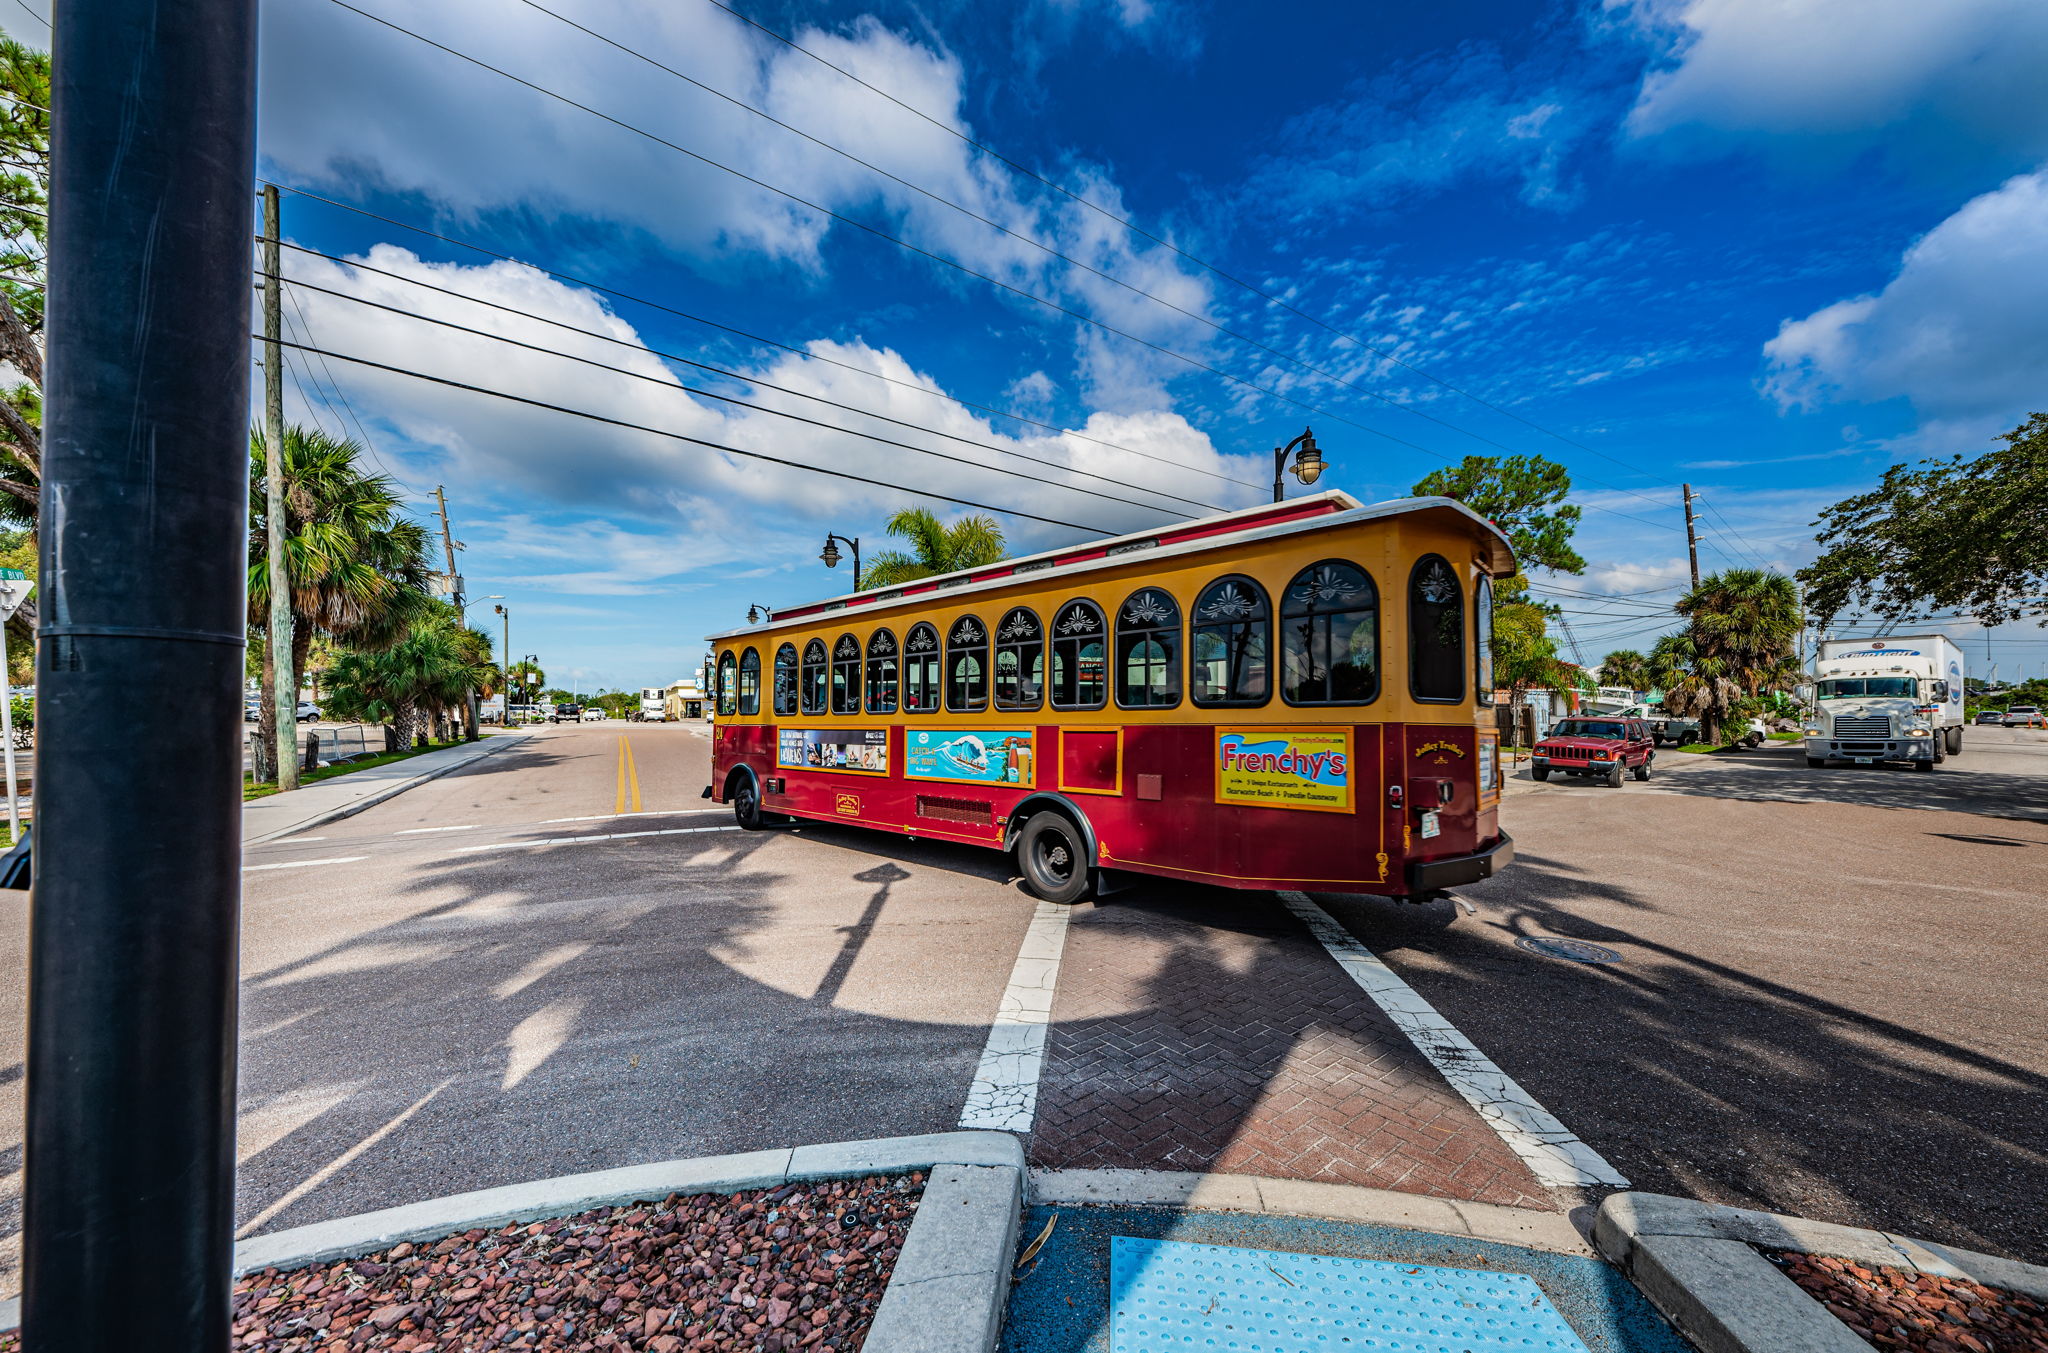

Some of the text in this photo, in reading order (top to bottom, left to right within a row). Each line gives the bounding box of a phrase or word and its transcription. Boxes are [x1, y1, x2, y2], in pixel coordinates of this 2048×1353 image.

[8, 570, 25, 580] BLVD
[1222, 743, 1346, 780] Frenchy's
[1226, 788, 1256, 796] Clearwater
[1257, 789, 1274, 797] Beach
